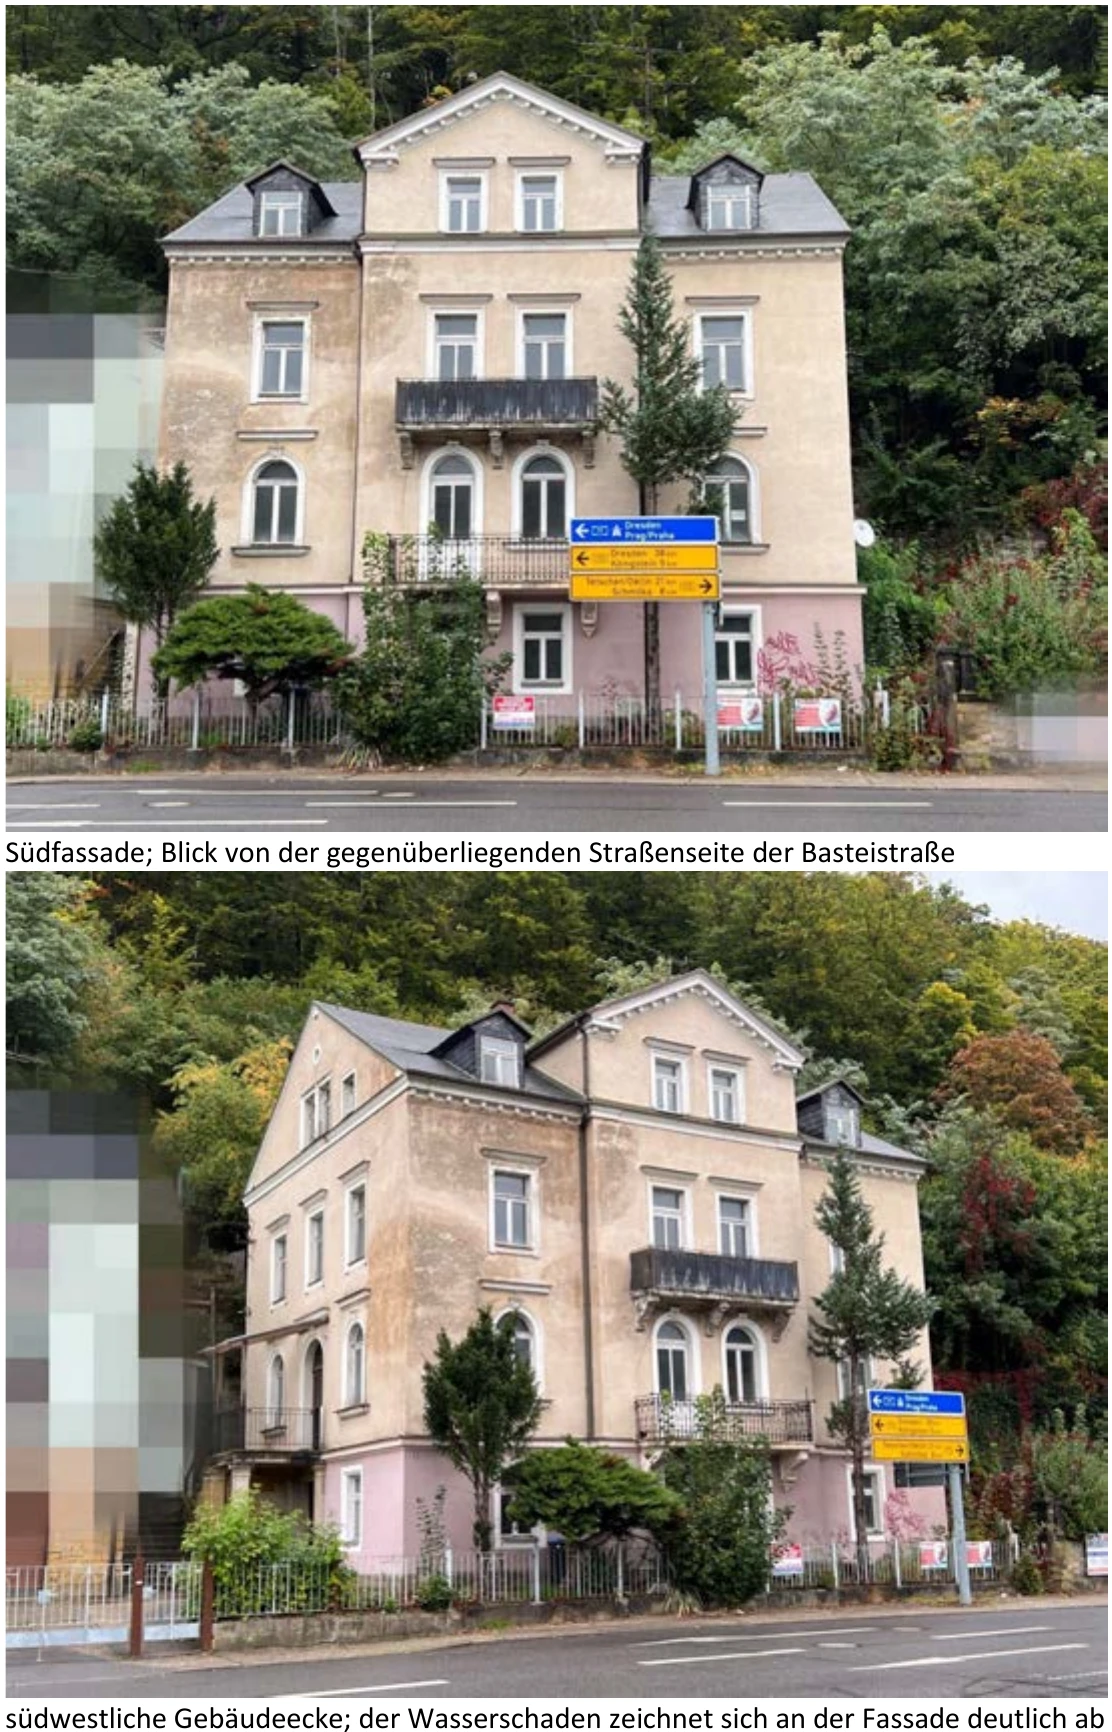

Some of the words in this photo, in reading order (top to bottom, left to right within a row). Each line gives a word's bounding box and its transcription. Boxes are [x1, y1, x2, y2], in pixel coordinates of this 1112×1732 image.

[625, 521, 662, 529] Dresden
[625, 532, 674, 542] Prag/Praha
[611, 549, 647, 557] Dresden
